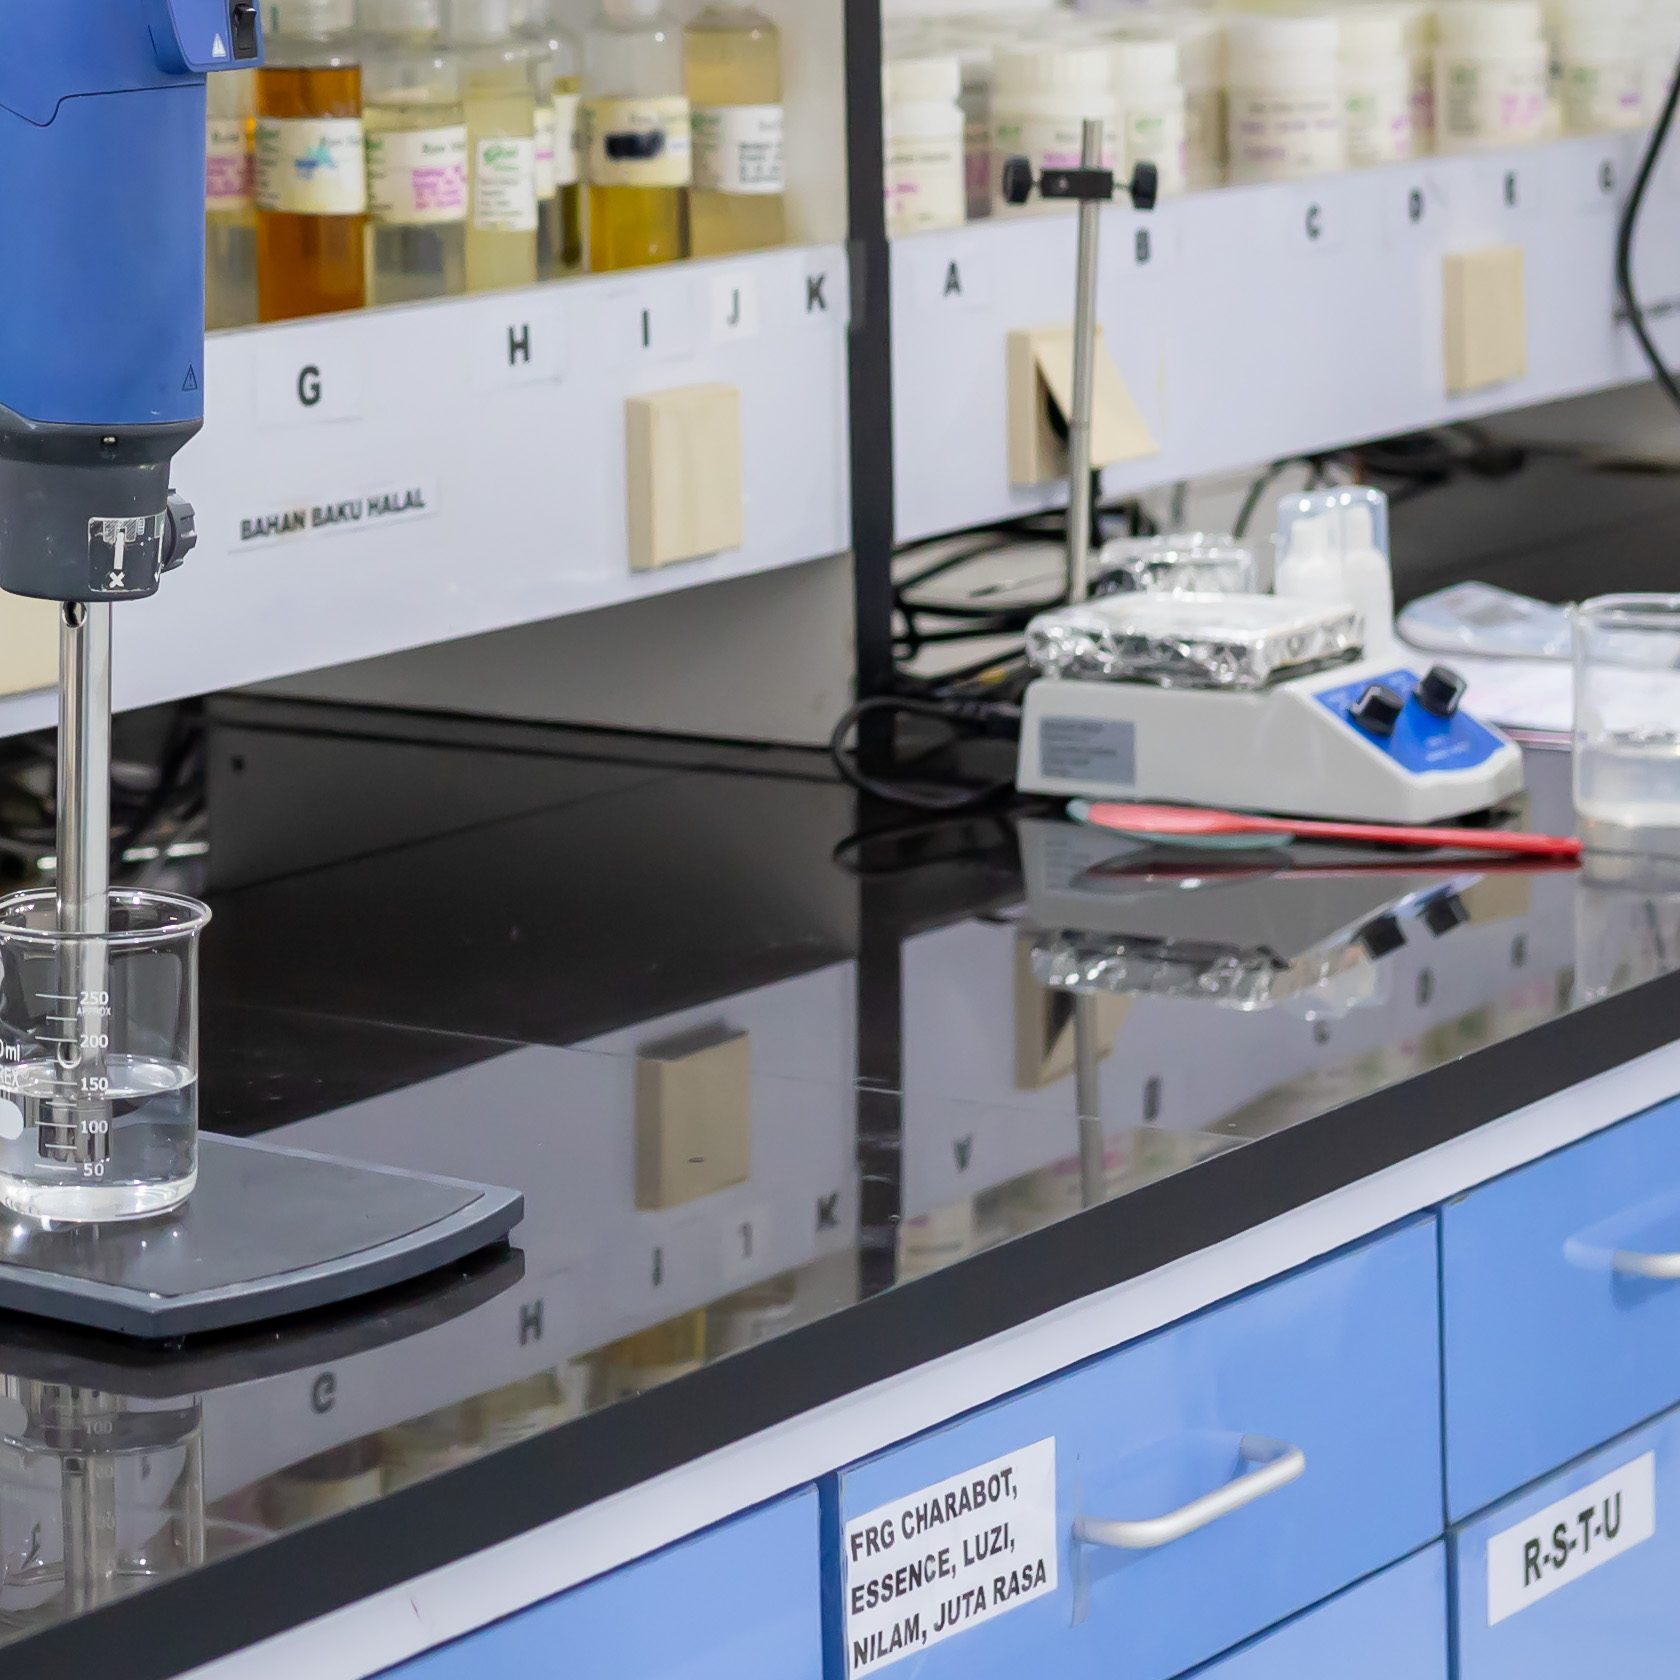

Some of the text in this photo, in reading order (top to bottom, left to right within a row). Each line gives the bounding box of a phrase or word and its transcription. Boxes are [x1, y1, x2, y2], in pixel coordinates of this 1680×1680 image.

[1304, 203, 1322, 241] C
[1133, 227, 1153, 266] B
[805, 272, 828, 313] K
[943, 260, 962, 296] A
[725, 287, 742, 328] J
[507, 323, 532, 367] H
[640, 308, 651, 349] I
[295, 364, 322, 409] G
[240, 487, 426, 541] BAHAN BAKU HALAL
[79, 991, 109, 1006] 250
[5, 1041, 22, 1062] ml
[79, 1034, 109, 1049] 200
[79, 1077, 109, 1092] 150
[79, 1120, 109, 1135] 100
[82, 1163, 105, 1178] 50
[850, 1466, 1018, 1563] FRG CHARABOT,
[1523, 1490, 1623, 1588] R-S-T-U
[851, 1521, 1016, 1616] ESSENCE, LUZI,
[853, 1558, 1047, 1670] NILAM, JUTA RASA
